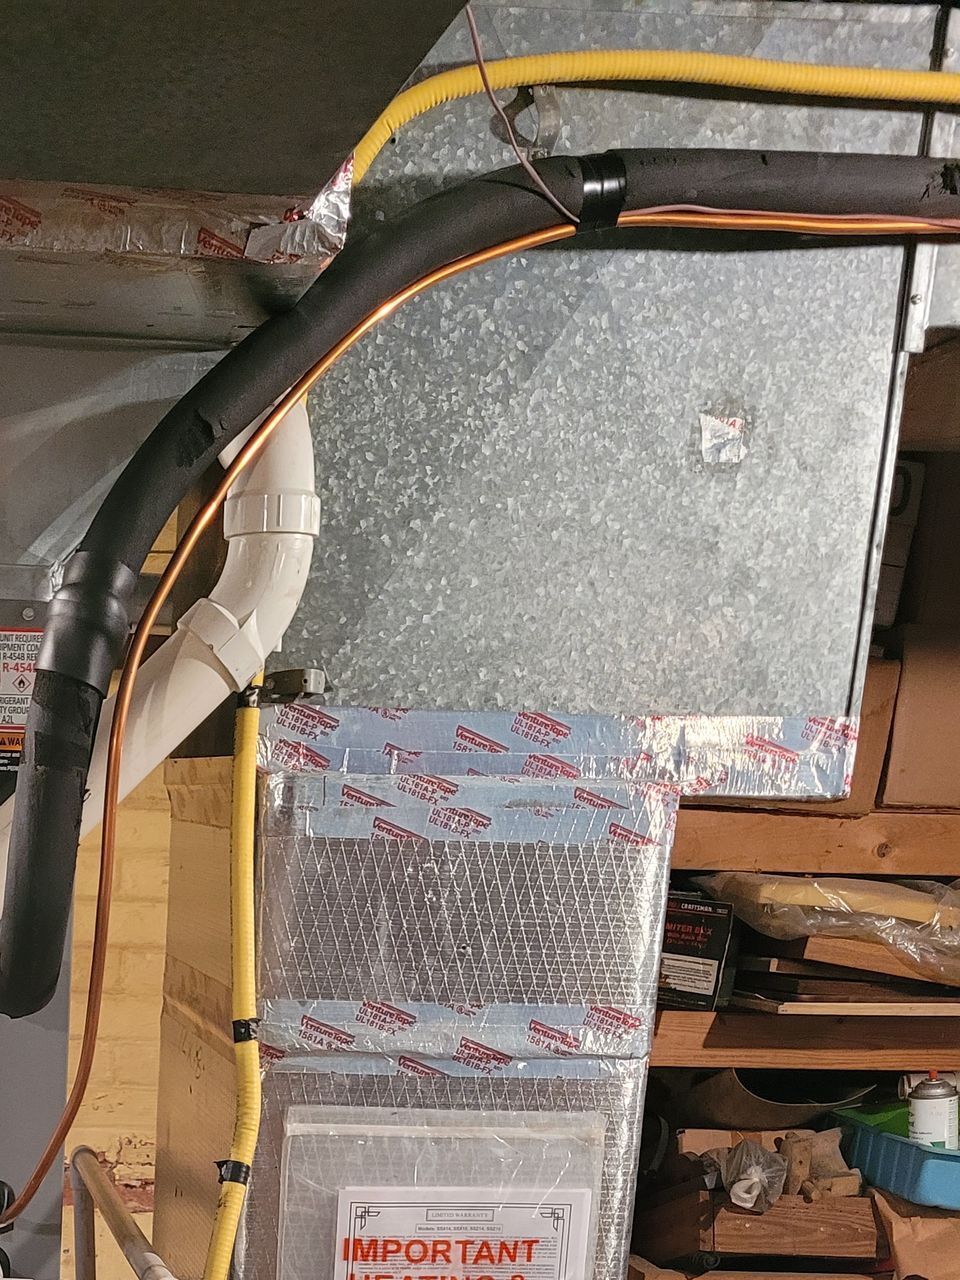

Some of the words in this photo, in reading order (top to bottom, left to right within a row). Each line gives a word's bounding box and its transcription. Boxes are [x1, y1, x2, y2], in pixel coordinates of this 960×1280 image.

[0, 634, 14, 642] UNIT
[1, 715, 14, 724] A2L
[280, 709, 318, 730] UL181A-P
[283, 702, 339, 732] VentureTape
[514, 717, 550, 738] UL181A-P
[518, 711, 569, 739] VentureTape
[276, 717, 319, 741] UL181B-FX
[511, 724, 552, 748] UL181B-FX
[397, 784, 439, 806] UL181B-FX
[400, 776, 438, 796] UL181A-P
[681, 903, 712, 912] CRAFTSMAN
[355, 1014, 397, 1036] UL181B-FX
[358, 1007, 396, 1025] UL181A-P
[362, 1001, 414, 1027] VentureTape
[298, 1029, 324, 1047] 1581A
[301, 1016, 355, 1046] VentureTape
[343, 1238, 540, 1264] IMPORTANT
